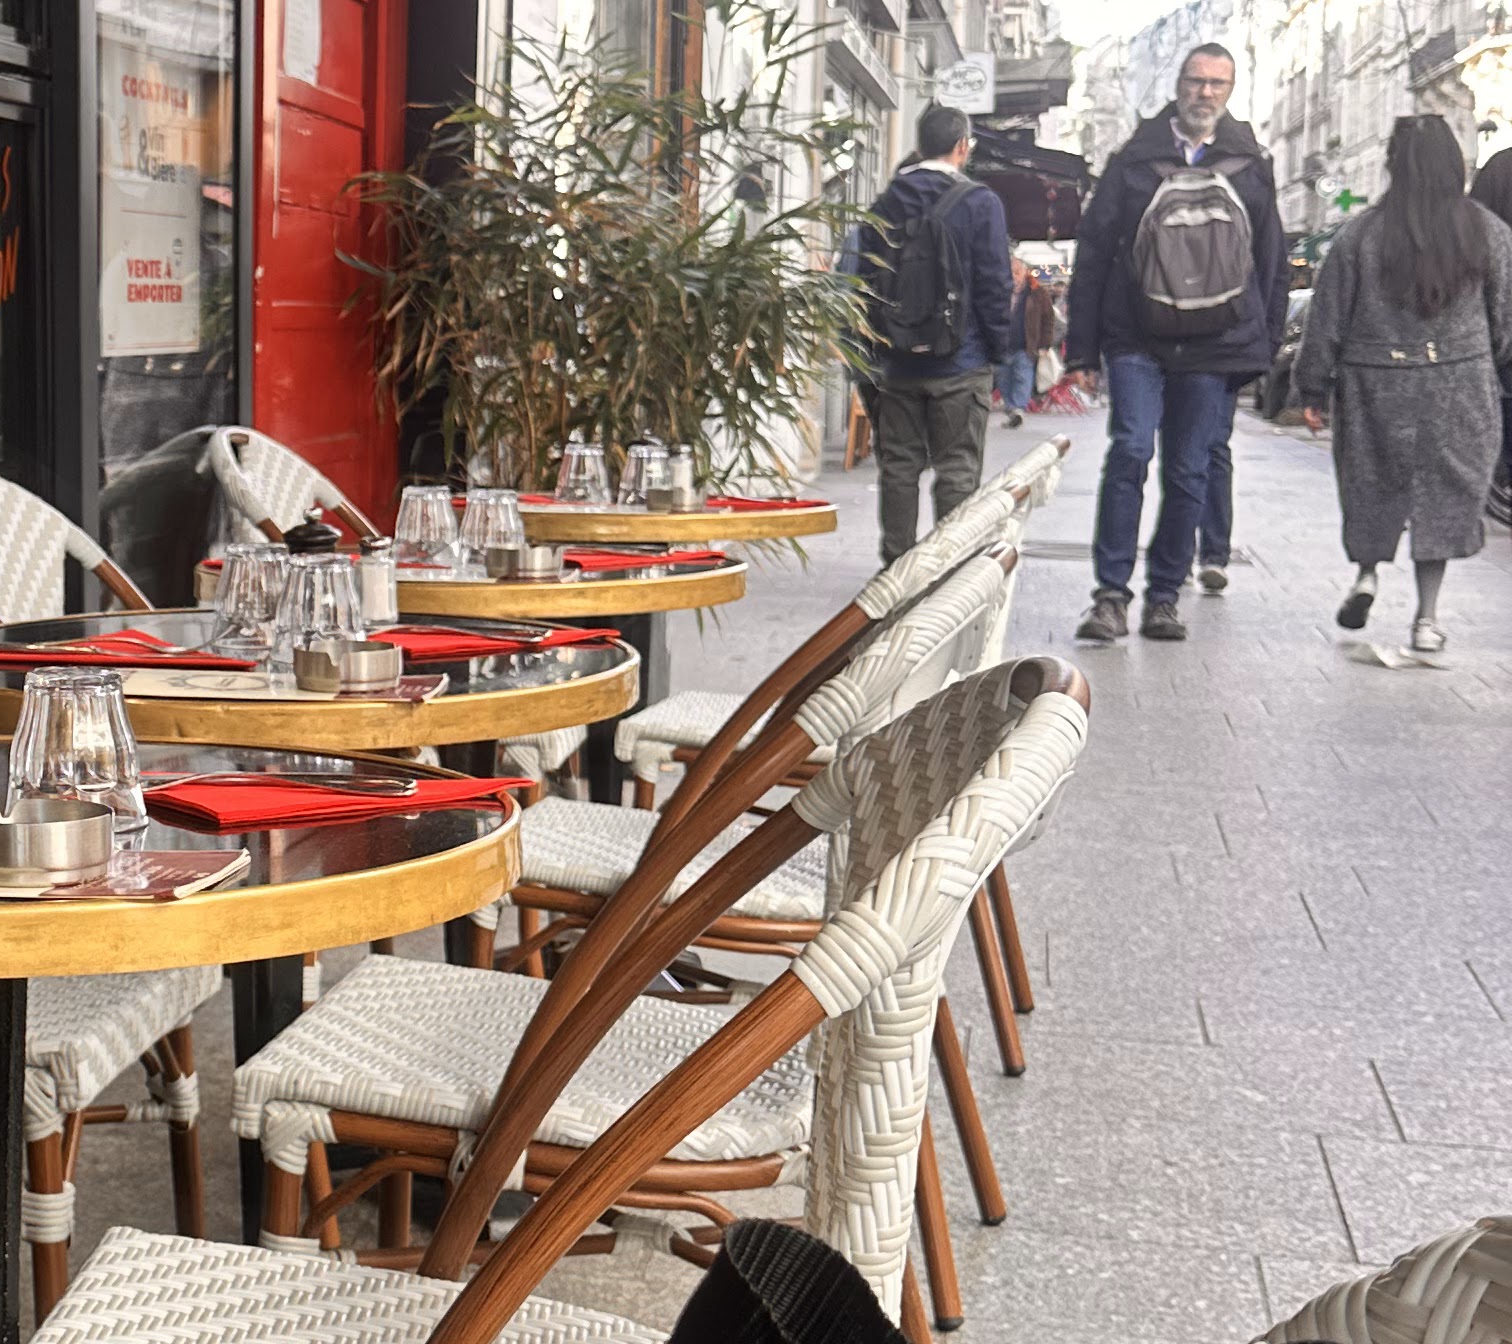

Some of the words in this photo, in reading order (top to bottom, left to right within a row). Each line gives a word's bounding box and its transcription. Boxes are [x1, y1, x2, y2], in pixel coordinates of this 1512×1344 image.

[121, 74, 188, 110] COCKTAILS
[126, 258, 162, 280] VENTE
[164, 256, 173, 280] À
[126, 283, 183, 304] EMPORTER
